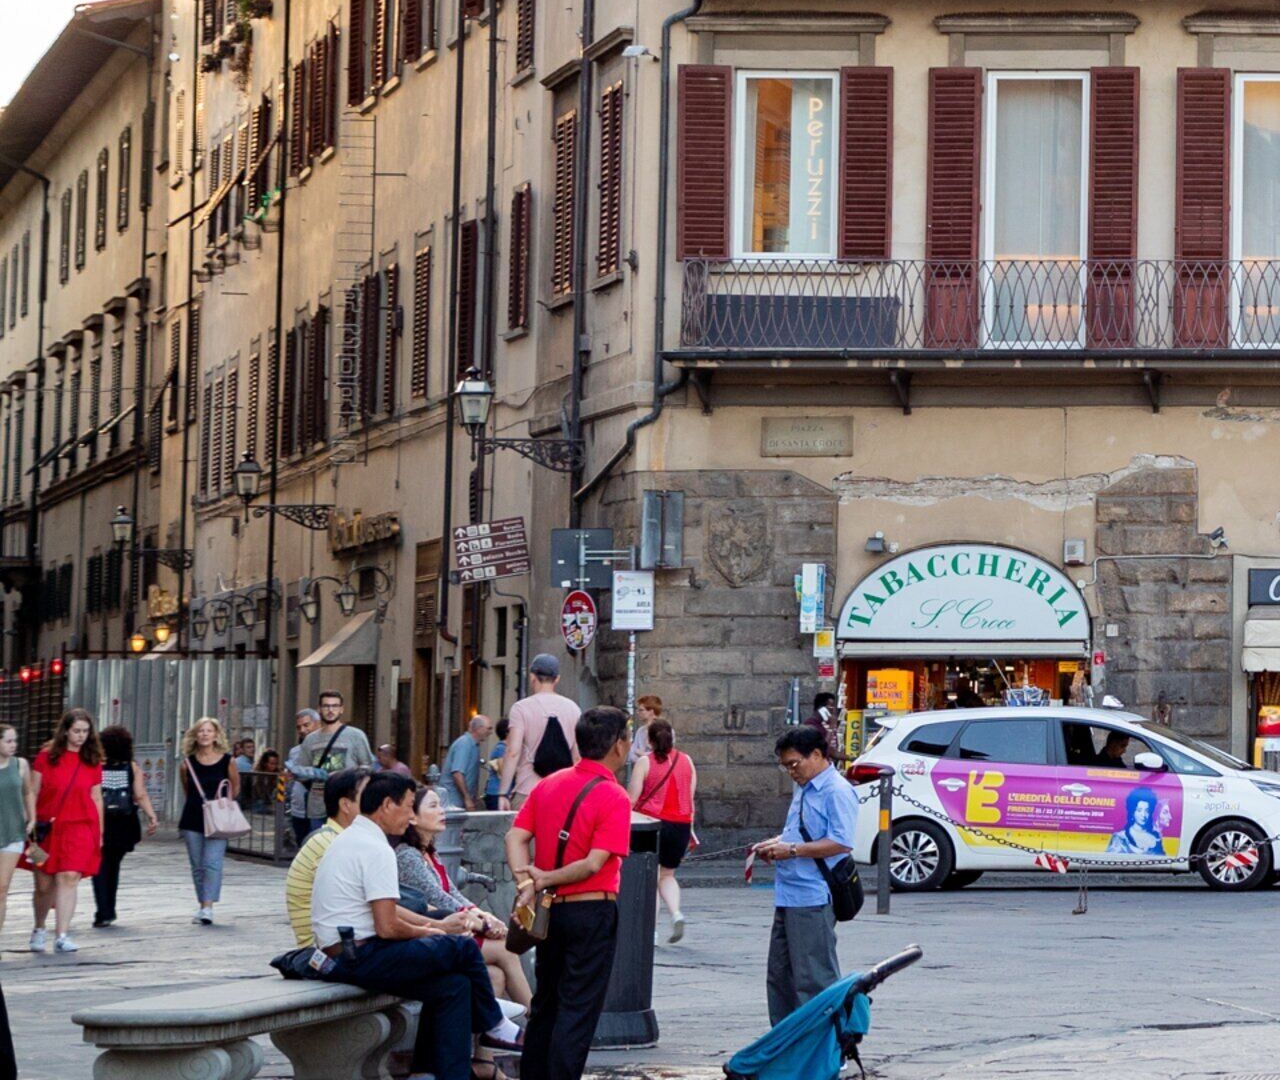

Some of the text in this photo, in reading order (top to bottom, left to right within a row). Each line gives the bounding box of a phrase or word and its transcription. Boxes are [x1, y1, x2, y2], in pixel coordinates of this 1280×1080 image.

[806, 97, 825, 240] Peruzzi
[847, 553, 1078, 628] TABACCHERIA
[957, 598, 1016, 630] Croce
[851, 721, 860, 756] CAS
[1054, 795, 1081, 805] DELLE
[1083, 797, 1116, 807] DONNE
